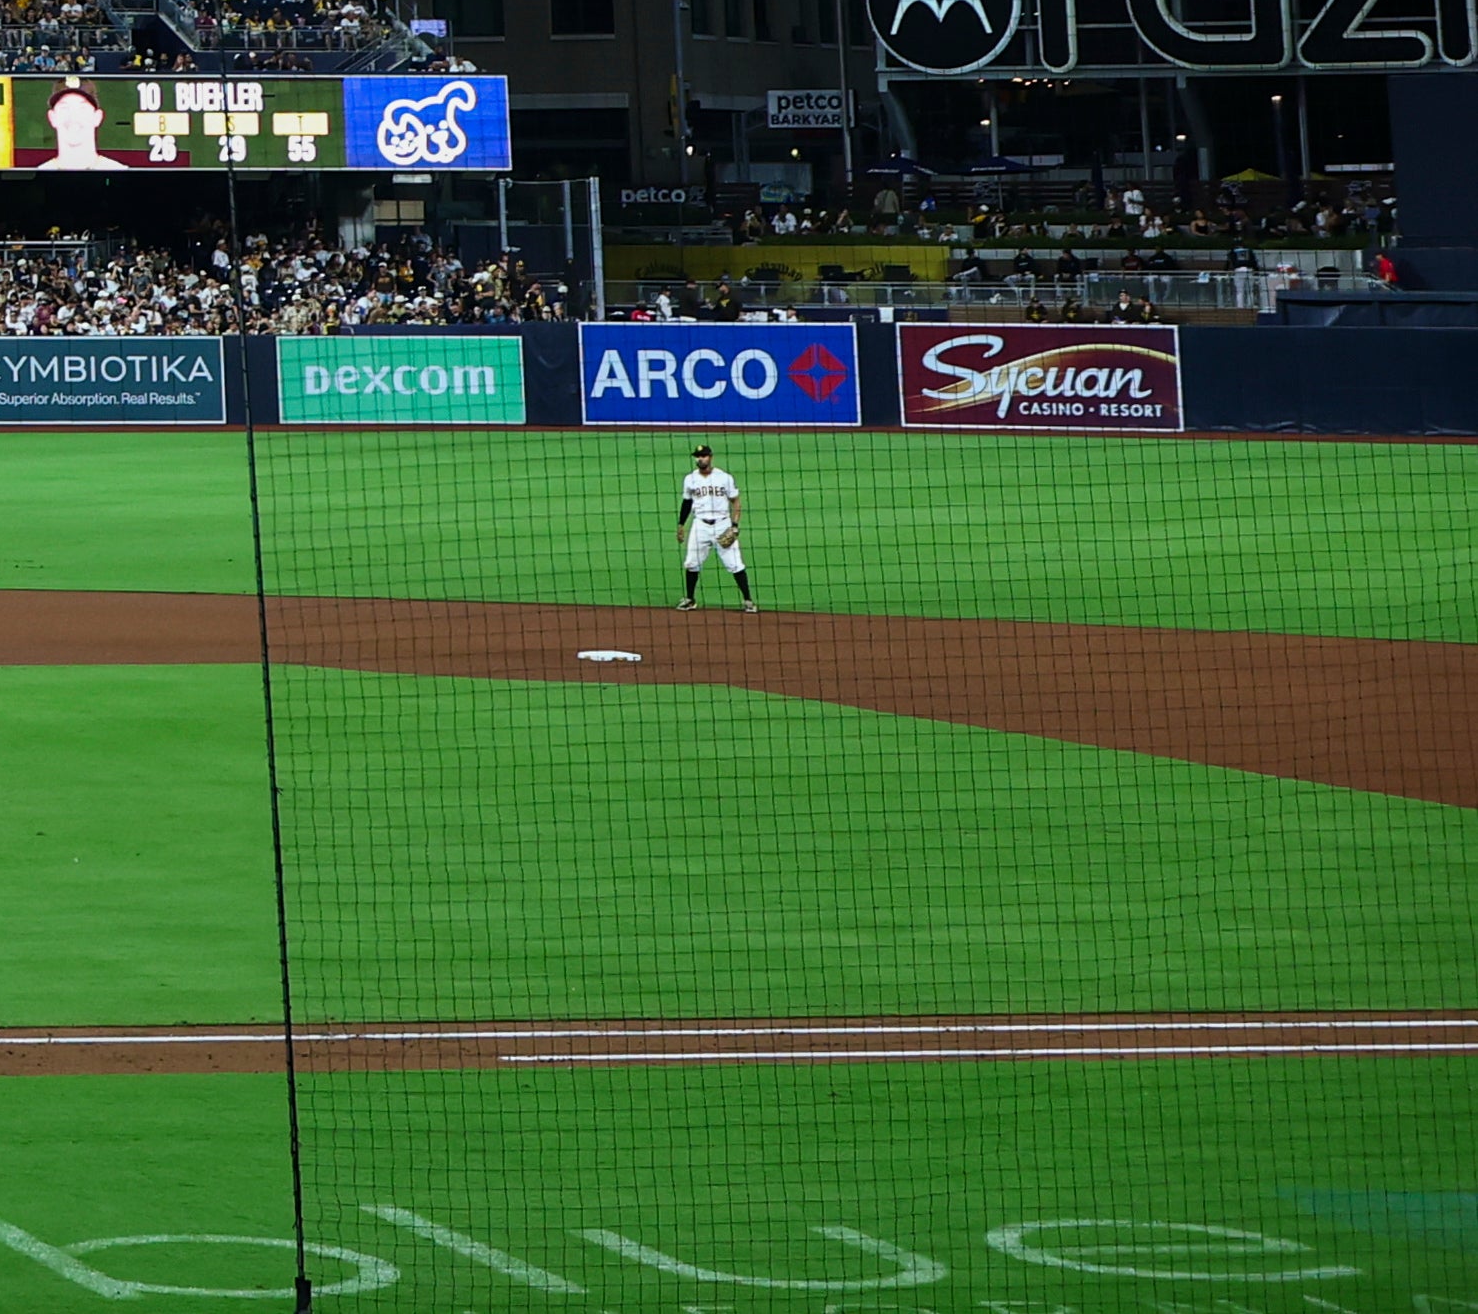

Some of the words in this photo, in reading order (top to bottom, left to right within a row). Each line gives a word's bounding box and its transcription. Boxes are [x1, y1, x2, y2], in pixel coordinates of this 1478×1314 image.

[137, 82, 162, 111] 10
[175, 82, 264, 112] BUEHLER
[776, 93, 843, 114] petco
[770, 113, 852, 126] BARKYAR
[621, 186, 687, 208] petco
[590, 349, 779, 400] ARCO
[920, 334, 1153, 419] Sycuan
[51, 392, 121, 407] Absorption.
[121, 392, 148, 405] Real
[1019, 401, 1086, 418] CASINO
[1100, 403, 1163, 419] RESORT
